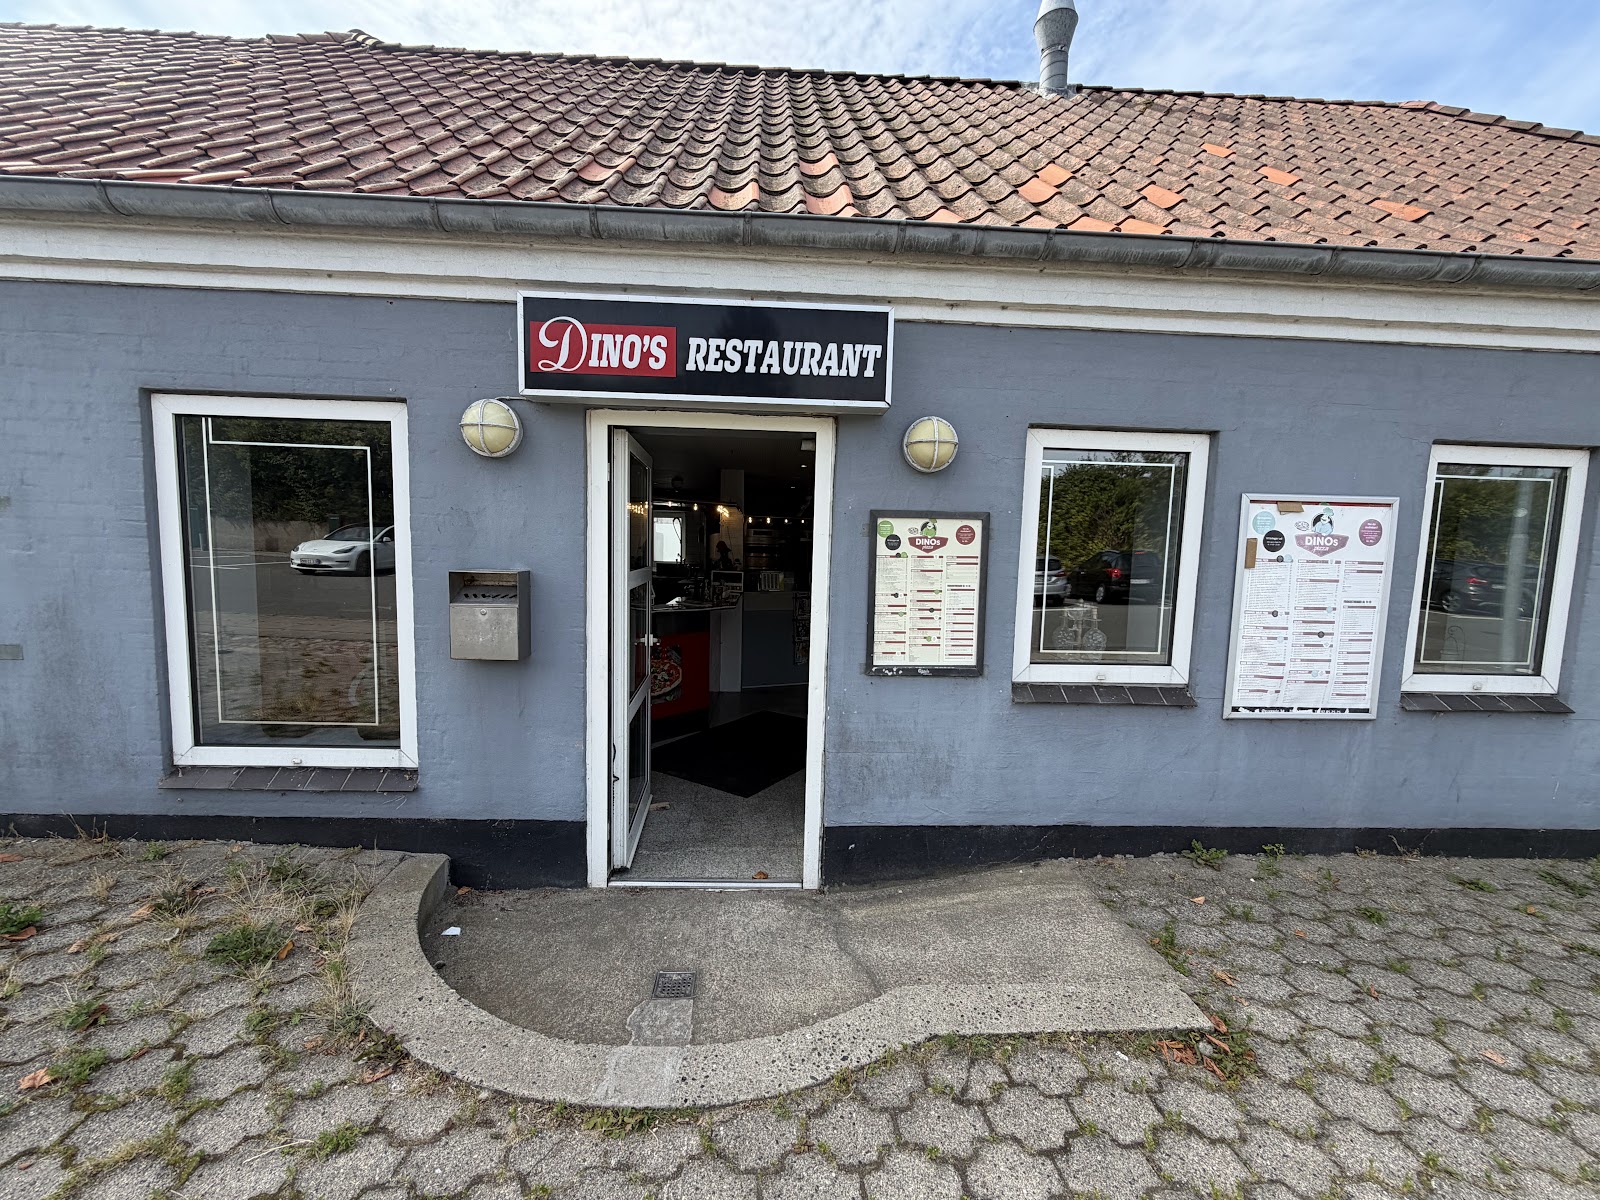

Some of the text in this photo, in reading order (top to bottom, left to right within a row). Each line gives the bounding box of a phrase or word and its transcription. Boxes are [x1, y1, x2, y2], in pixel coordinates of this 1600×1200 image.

[538, 316, 883, 378] DINO'S RESTAURANT
[915, 538, 941, 546] DINOs
[1305, 536, 1338, 547] DINOs
